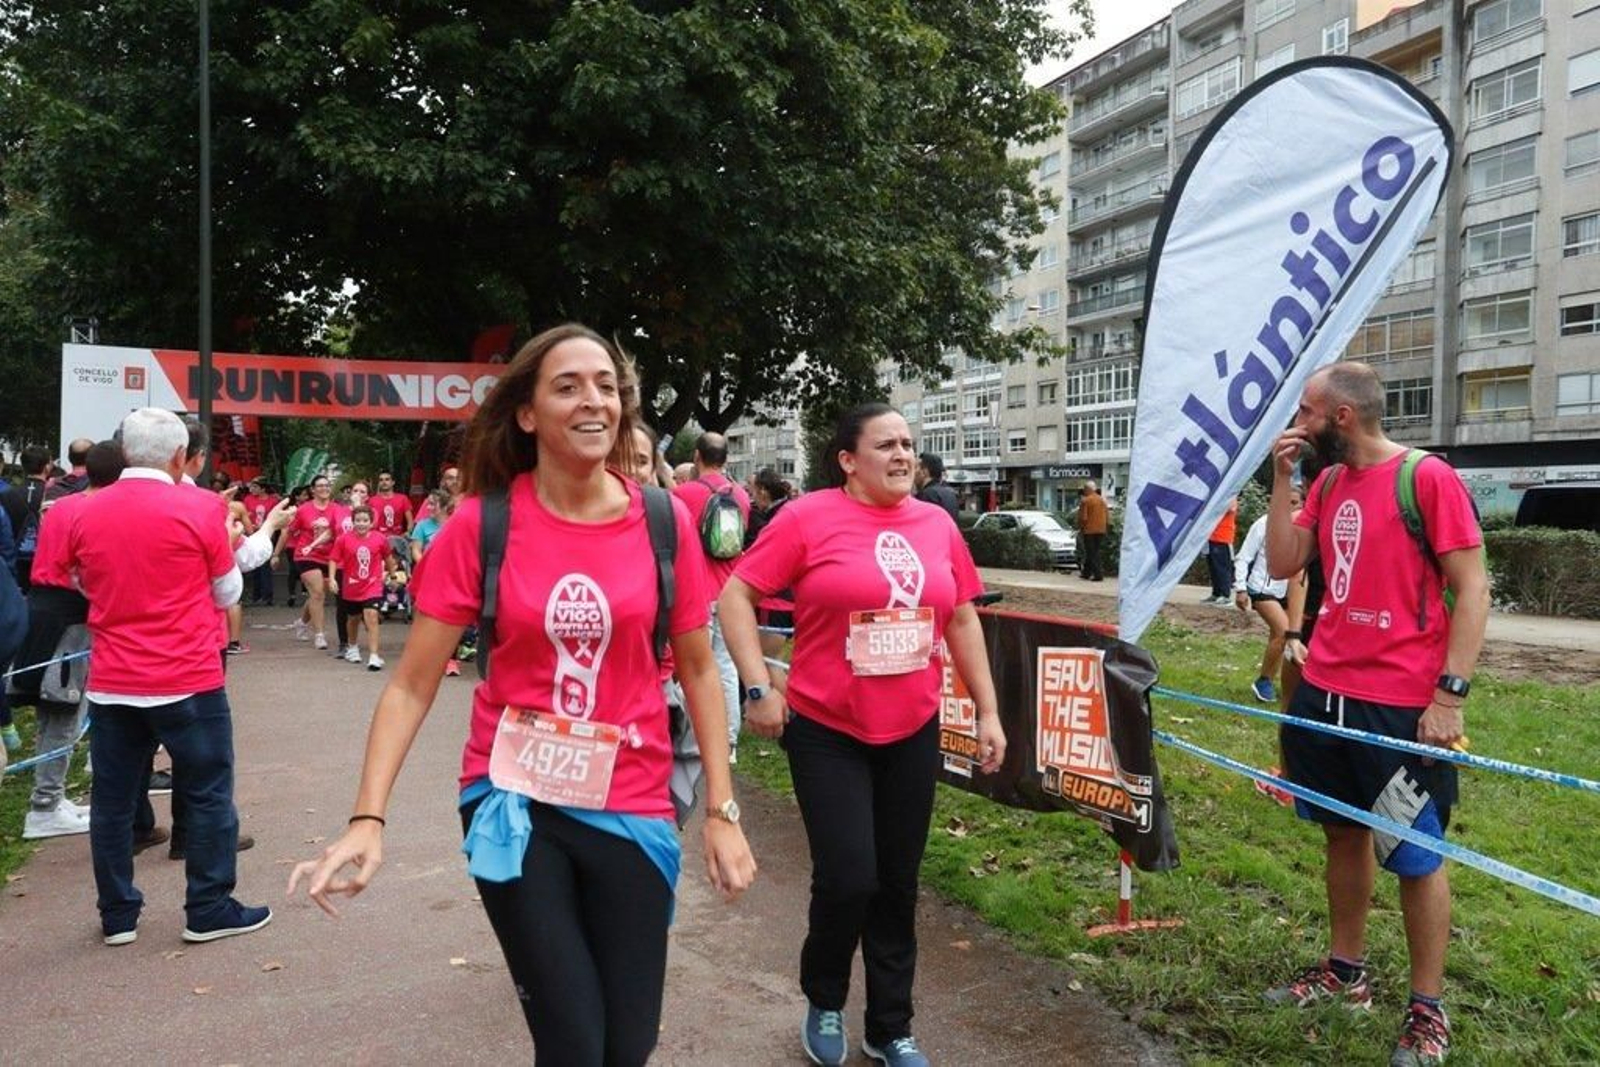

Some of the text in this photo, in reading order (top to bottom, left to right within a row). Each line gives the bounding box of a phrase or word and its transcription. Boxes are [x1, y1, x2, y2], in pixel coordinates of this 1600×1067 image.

[1136, 135, 1416, 571] Atlántico
[73, 367, 119, 377] CONCELLO
[78, 375, 114, 384] DE VIGO
[1050, 466, 1090, 477] farmacia
[564, 584, 588, 602] VI
[555, 609, 601, 622] VIGO
[868, 629, 919, 655] 5933
[1042, 694, 1092, 730] THE
[516, 739, 591, 782] 4925
